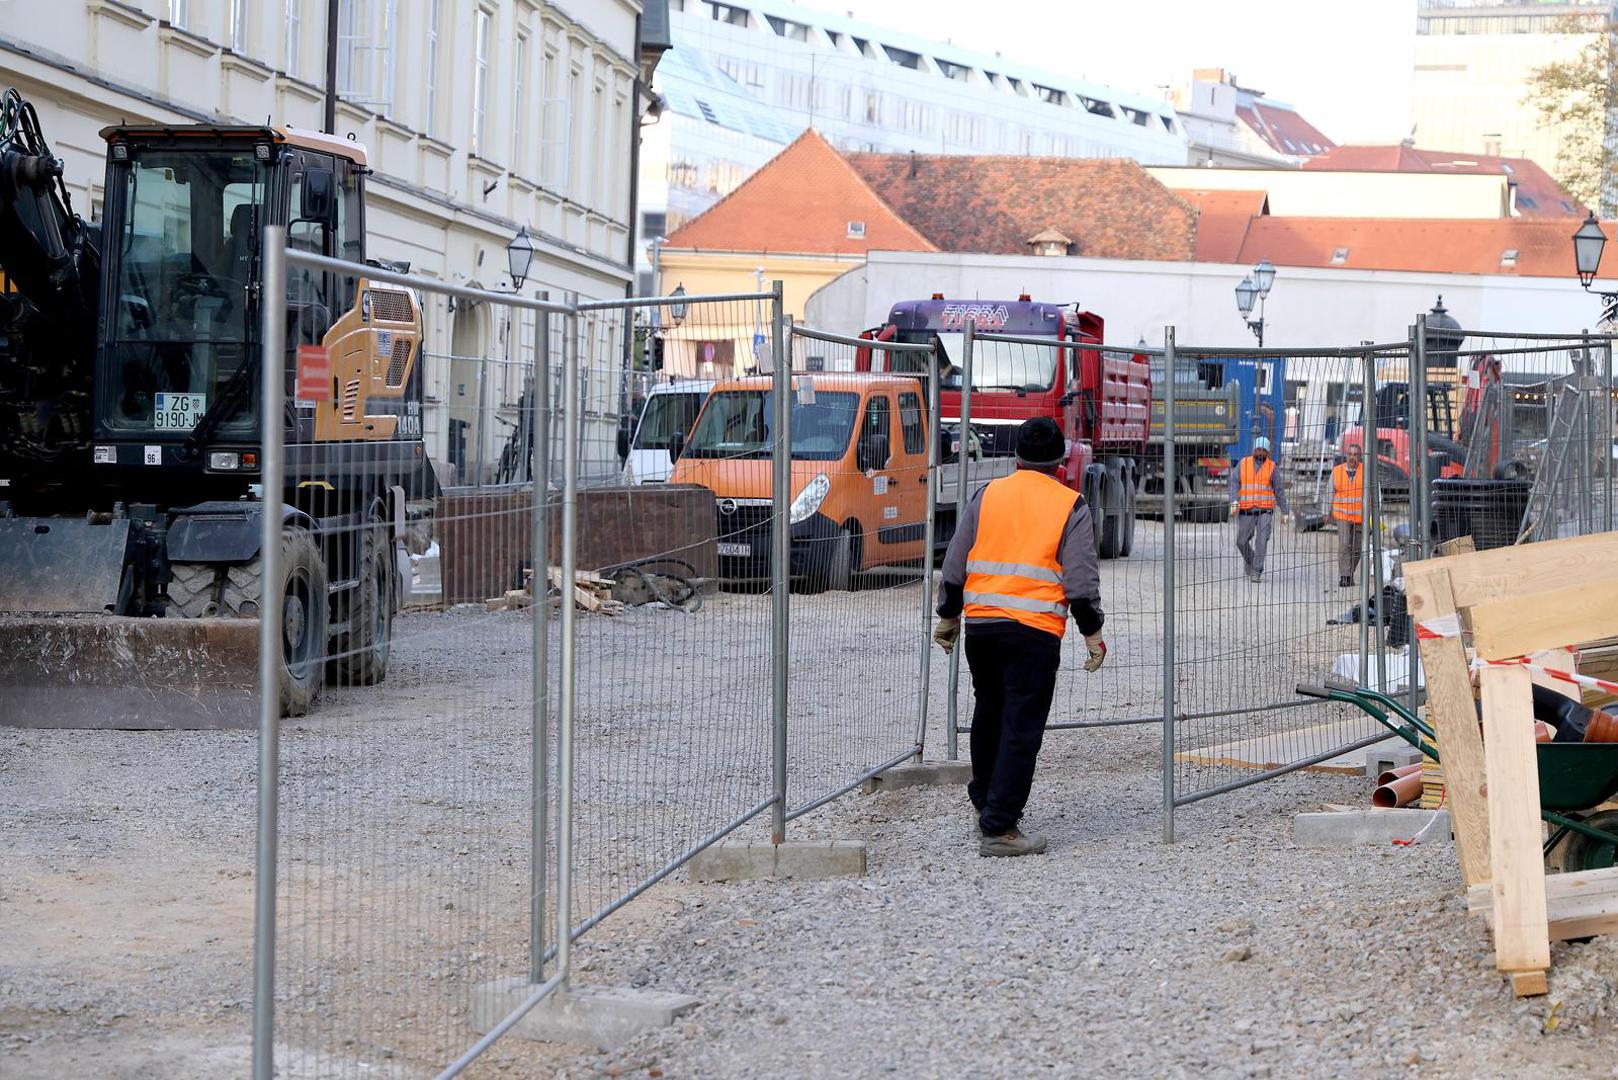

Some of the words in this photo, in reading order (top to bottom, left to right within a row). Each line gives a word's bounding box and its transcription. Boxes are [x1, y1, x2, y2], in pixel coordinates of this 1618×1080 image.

[171, 396, 190, 411] ZG
[398, 416, 420, 434] 140A
[147, 453, 156, 463] 96
